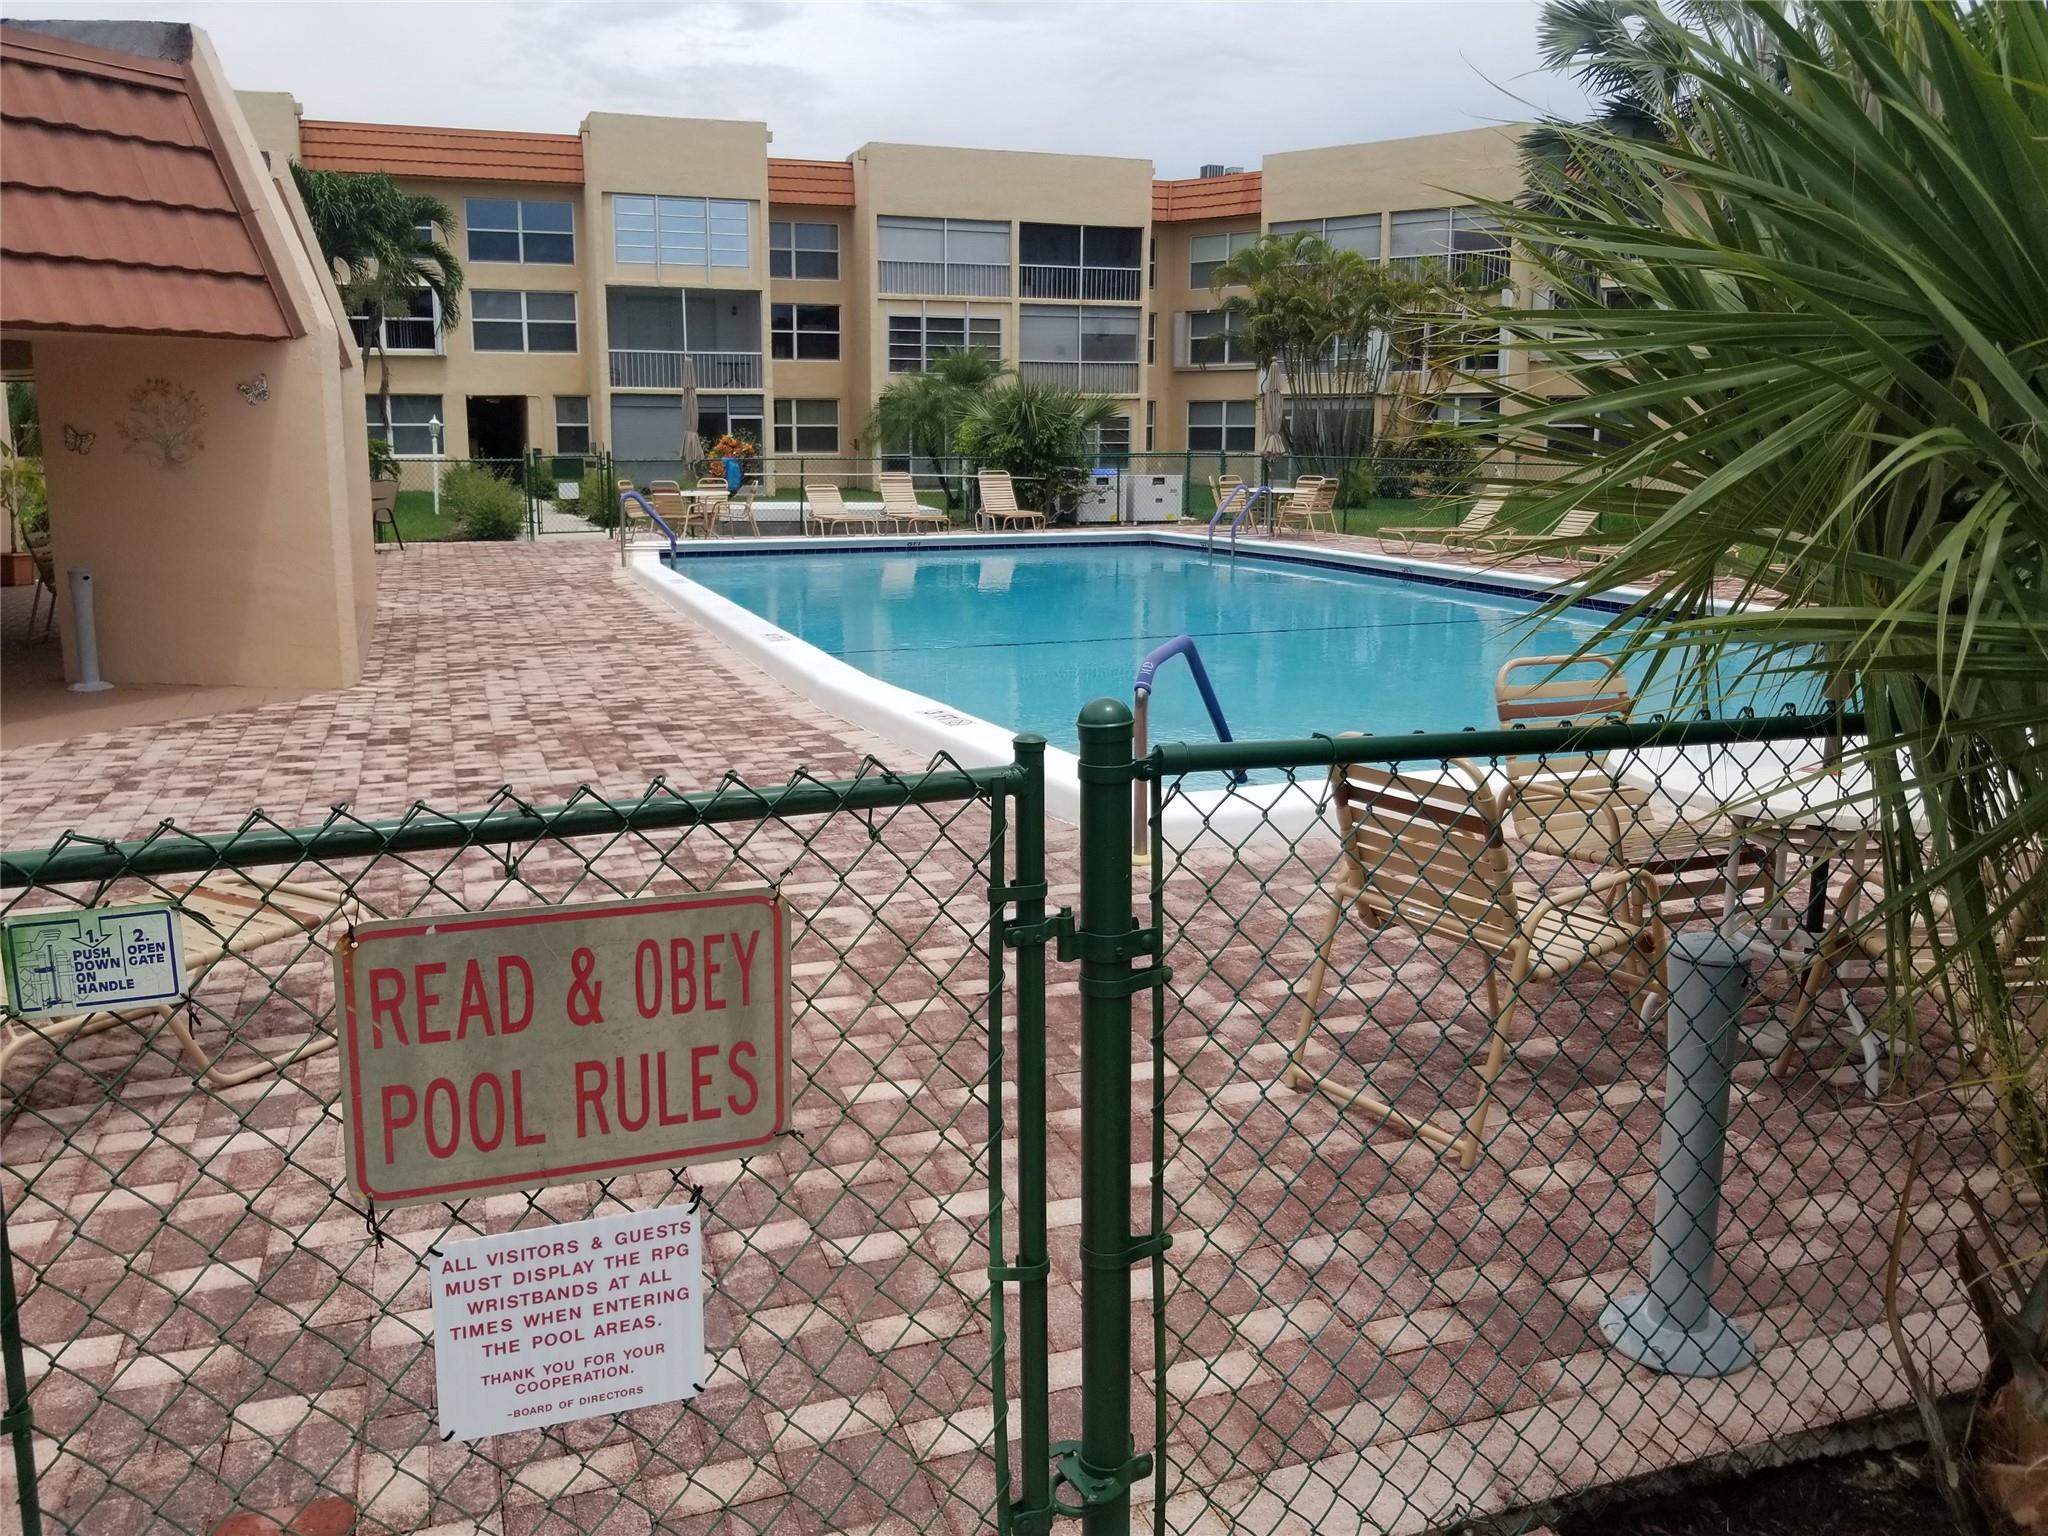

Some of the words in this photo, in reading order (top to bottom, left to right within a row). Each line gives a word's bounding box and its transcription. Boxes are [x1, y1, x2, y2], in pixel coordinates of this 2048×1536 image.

[85, 929, 100, 943] 1.
[127, 942, 166, 955] OPEN
[133, 928, 150, 942] 2.
[73, 947, 111, 961] PUSH
[74, 958, 121, 972] DOWN
[128, 953, 165, 966] GATE
[76, 972, 97, 984] ON
[77, 979, 135, 995] HANDLE
[369, 955, 535, 1050] READ
[566, 947, 602, 1026] &
[634, 930, 760, 1019] OBEY
[381, 1069, 546, 1165] POOL
[575, 1040, 759, 1139] RULES
[442, 1257, 477, 1275] ALL
[486, 1240, 579, 1266] VISITORS
[591, 1236, 603, 1250] &
[615, 1221, 692, 1246] GUESTS
[445, 1275, 502, 1296] MUST
[513, 1259, 594, 1286] DISPLAY
[604, 1252, 640, 1270] THE
[652, 1244, 689, 1262] RPG
[467, 1281, 598, 1315] WRISTBANDS
[608, 1276, 630, 1291] AT
[639, 1269, 672, 1285] ALL
[450, 1319, 513, 1341] TIMES
[523, 1306, 582, 1328] WHEN
[593, 1287, 690, 1316] ENTERING
[482, 1339, 521, 1358] THE
[532, 1329, 584, 1349] POOL
[593, 1315, 662, 1338] AREAS.
[481, 1367, 535, 1386] THANK
[543, 1359, 575, 1376] YOU
[584, 1352, 615, 1368] FOR
[623, 1343, 665, 1360] YOUR
[515, 1364, 635, 1395] COOPERATION.
[559, 1399, 574, 1409] OF
[579, 1386, 644, 1406] DIRECTORS
